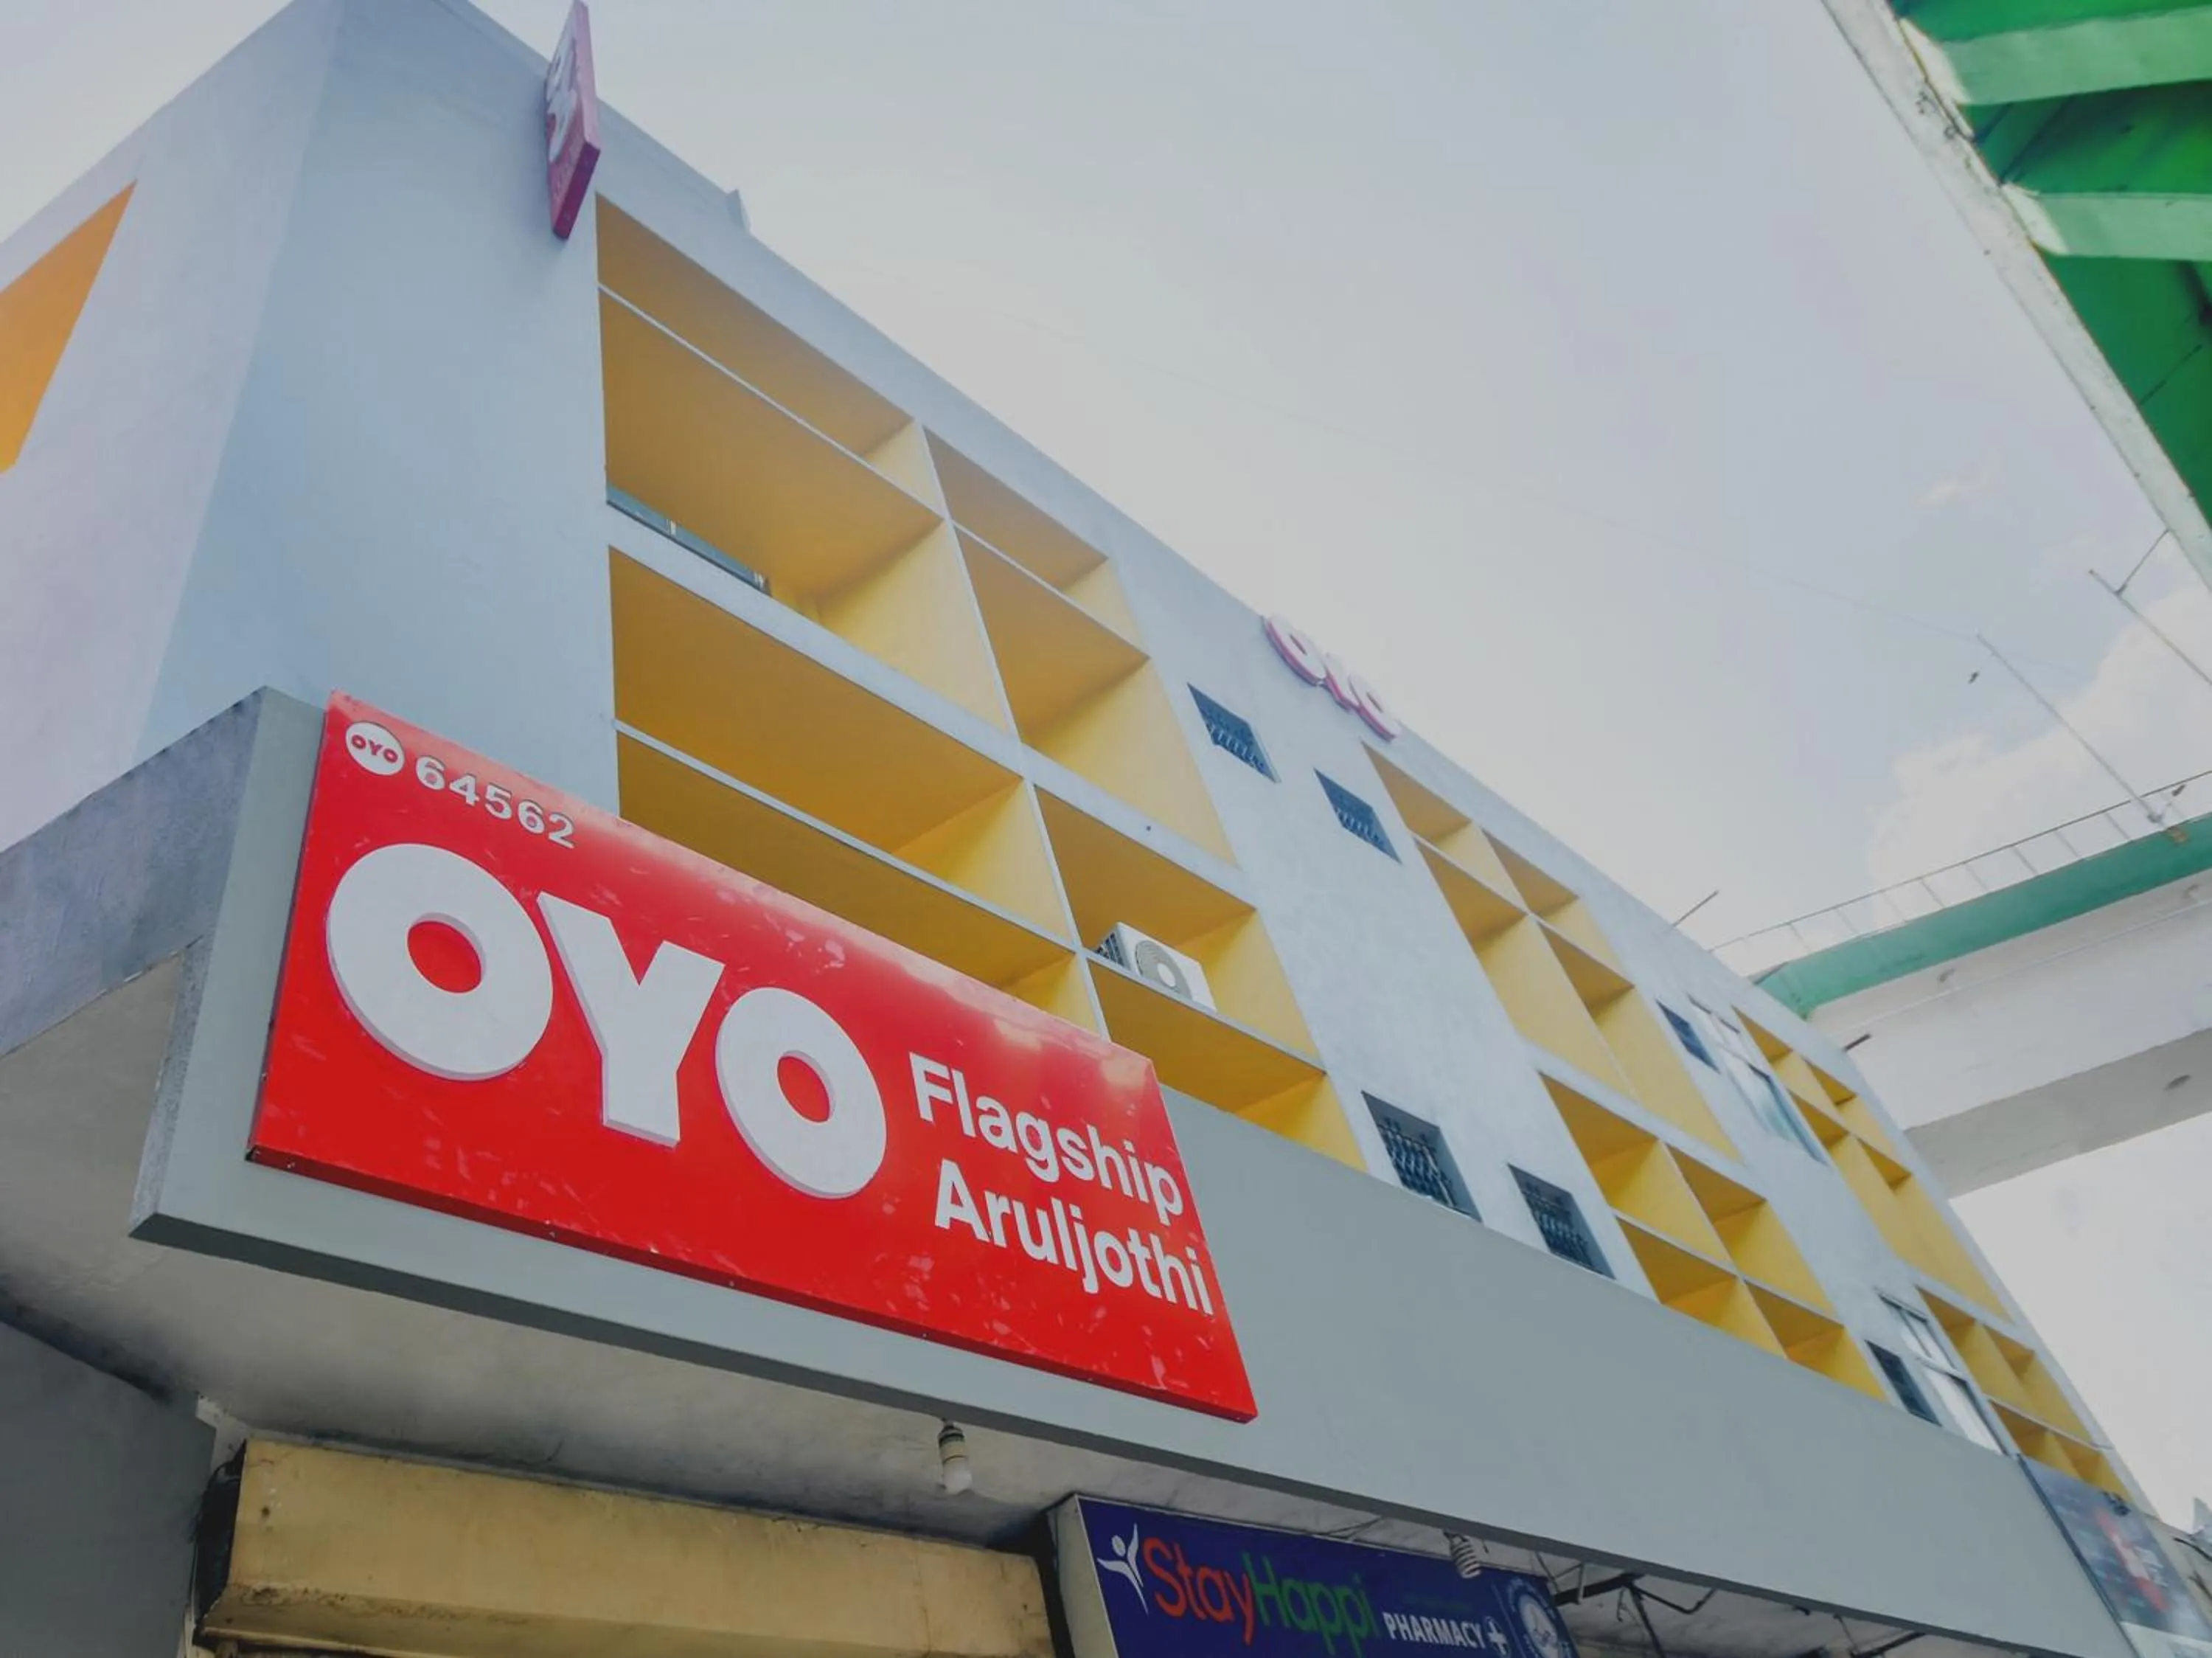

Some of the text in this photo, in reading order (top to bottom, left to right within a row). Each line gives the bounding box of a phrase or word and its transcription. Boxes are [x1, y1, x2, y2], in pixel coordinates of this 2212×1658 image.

[350, 734, 575, 849] OYO 64562
[326, 843, 887, 1200] OYO
[908, 1051, 1183, 1224] Flagship
[934, 1158, 1214, 1316] Aruljothi
[1382, 1612, 1486, 1649] PHARMACY
